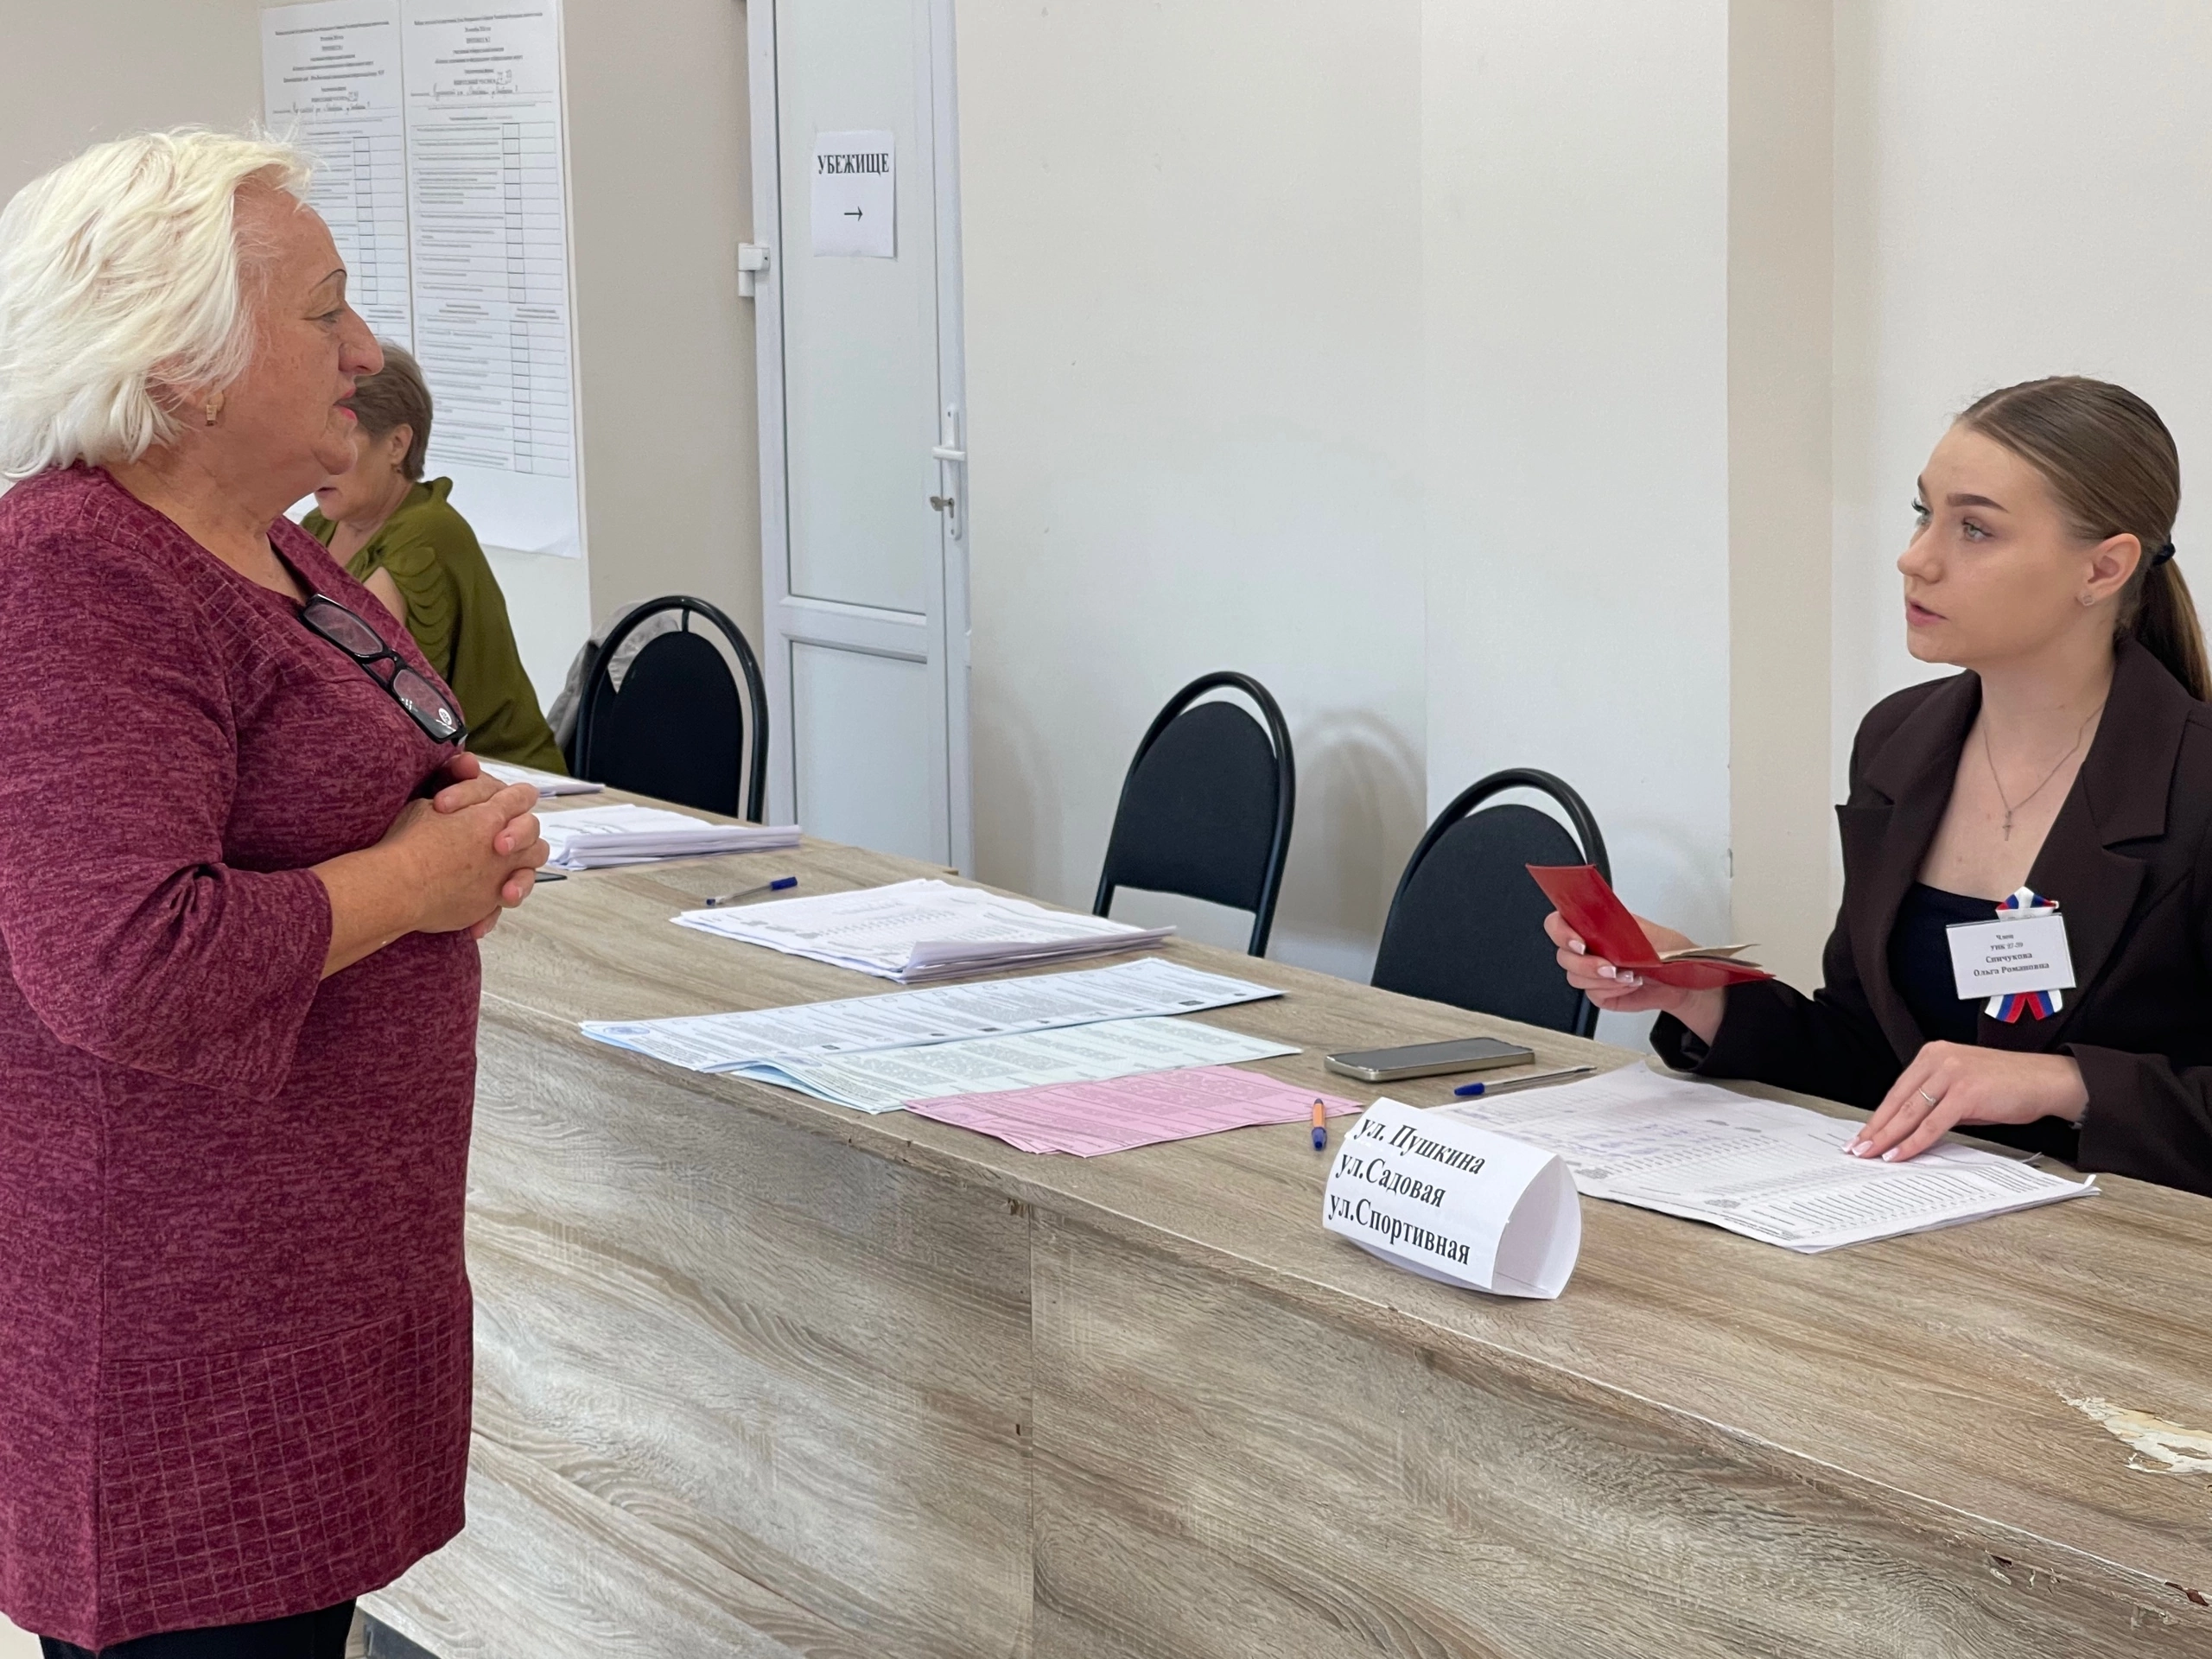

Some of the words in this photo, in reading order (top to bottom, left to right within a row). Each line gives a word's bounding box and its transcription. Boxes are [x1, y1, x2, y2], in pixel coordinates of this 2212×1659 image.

[817, 153, 889, 176] УБЕЖИЩЕ
[1974, 969, 1999, 977] Ольга
[2001, 963, 2050, 974] Романовна
[1354, 1118, 1384, 1141] ул.
[1388, 1124, 1485, 1176] Пушкина
[1335, 1154, 1446, 1208] ул.Садовая
[1328, 1194, 1471, 1266] ул.Спортивная
